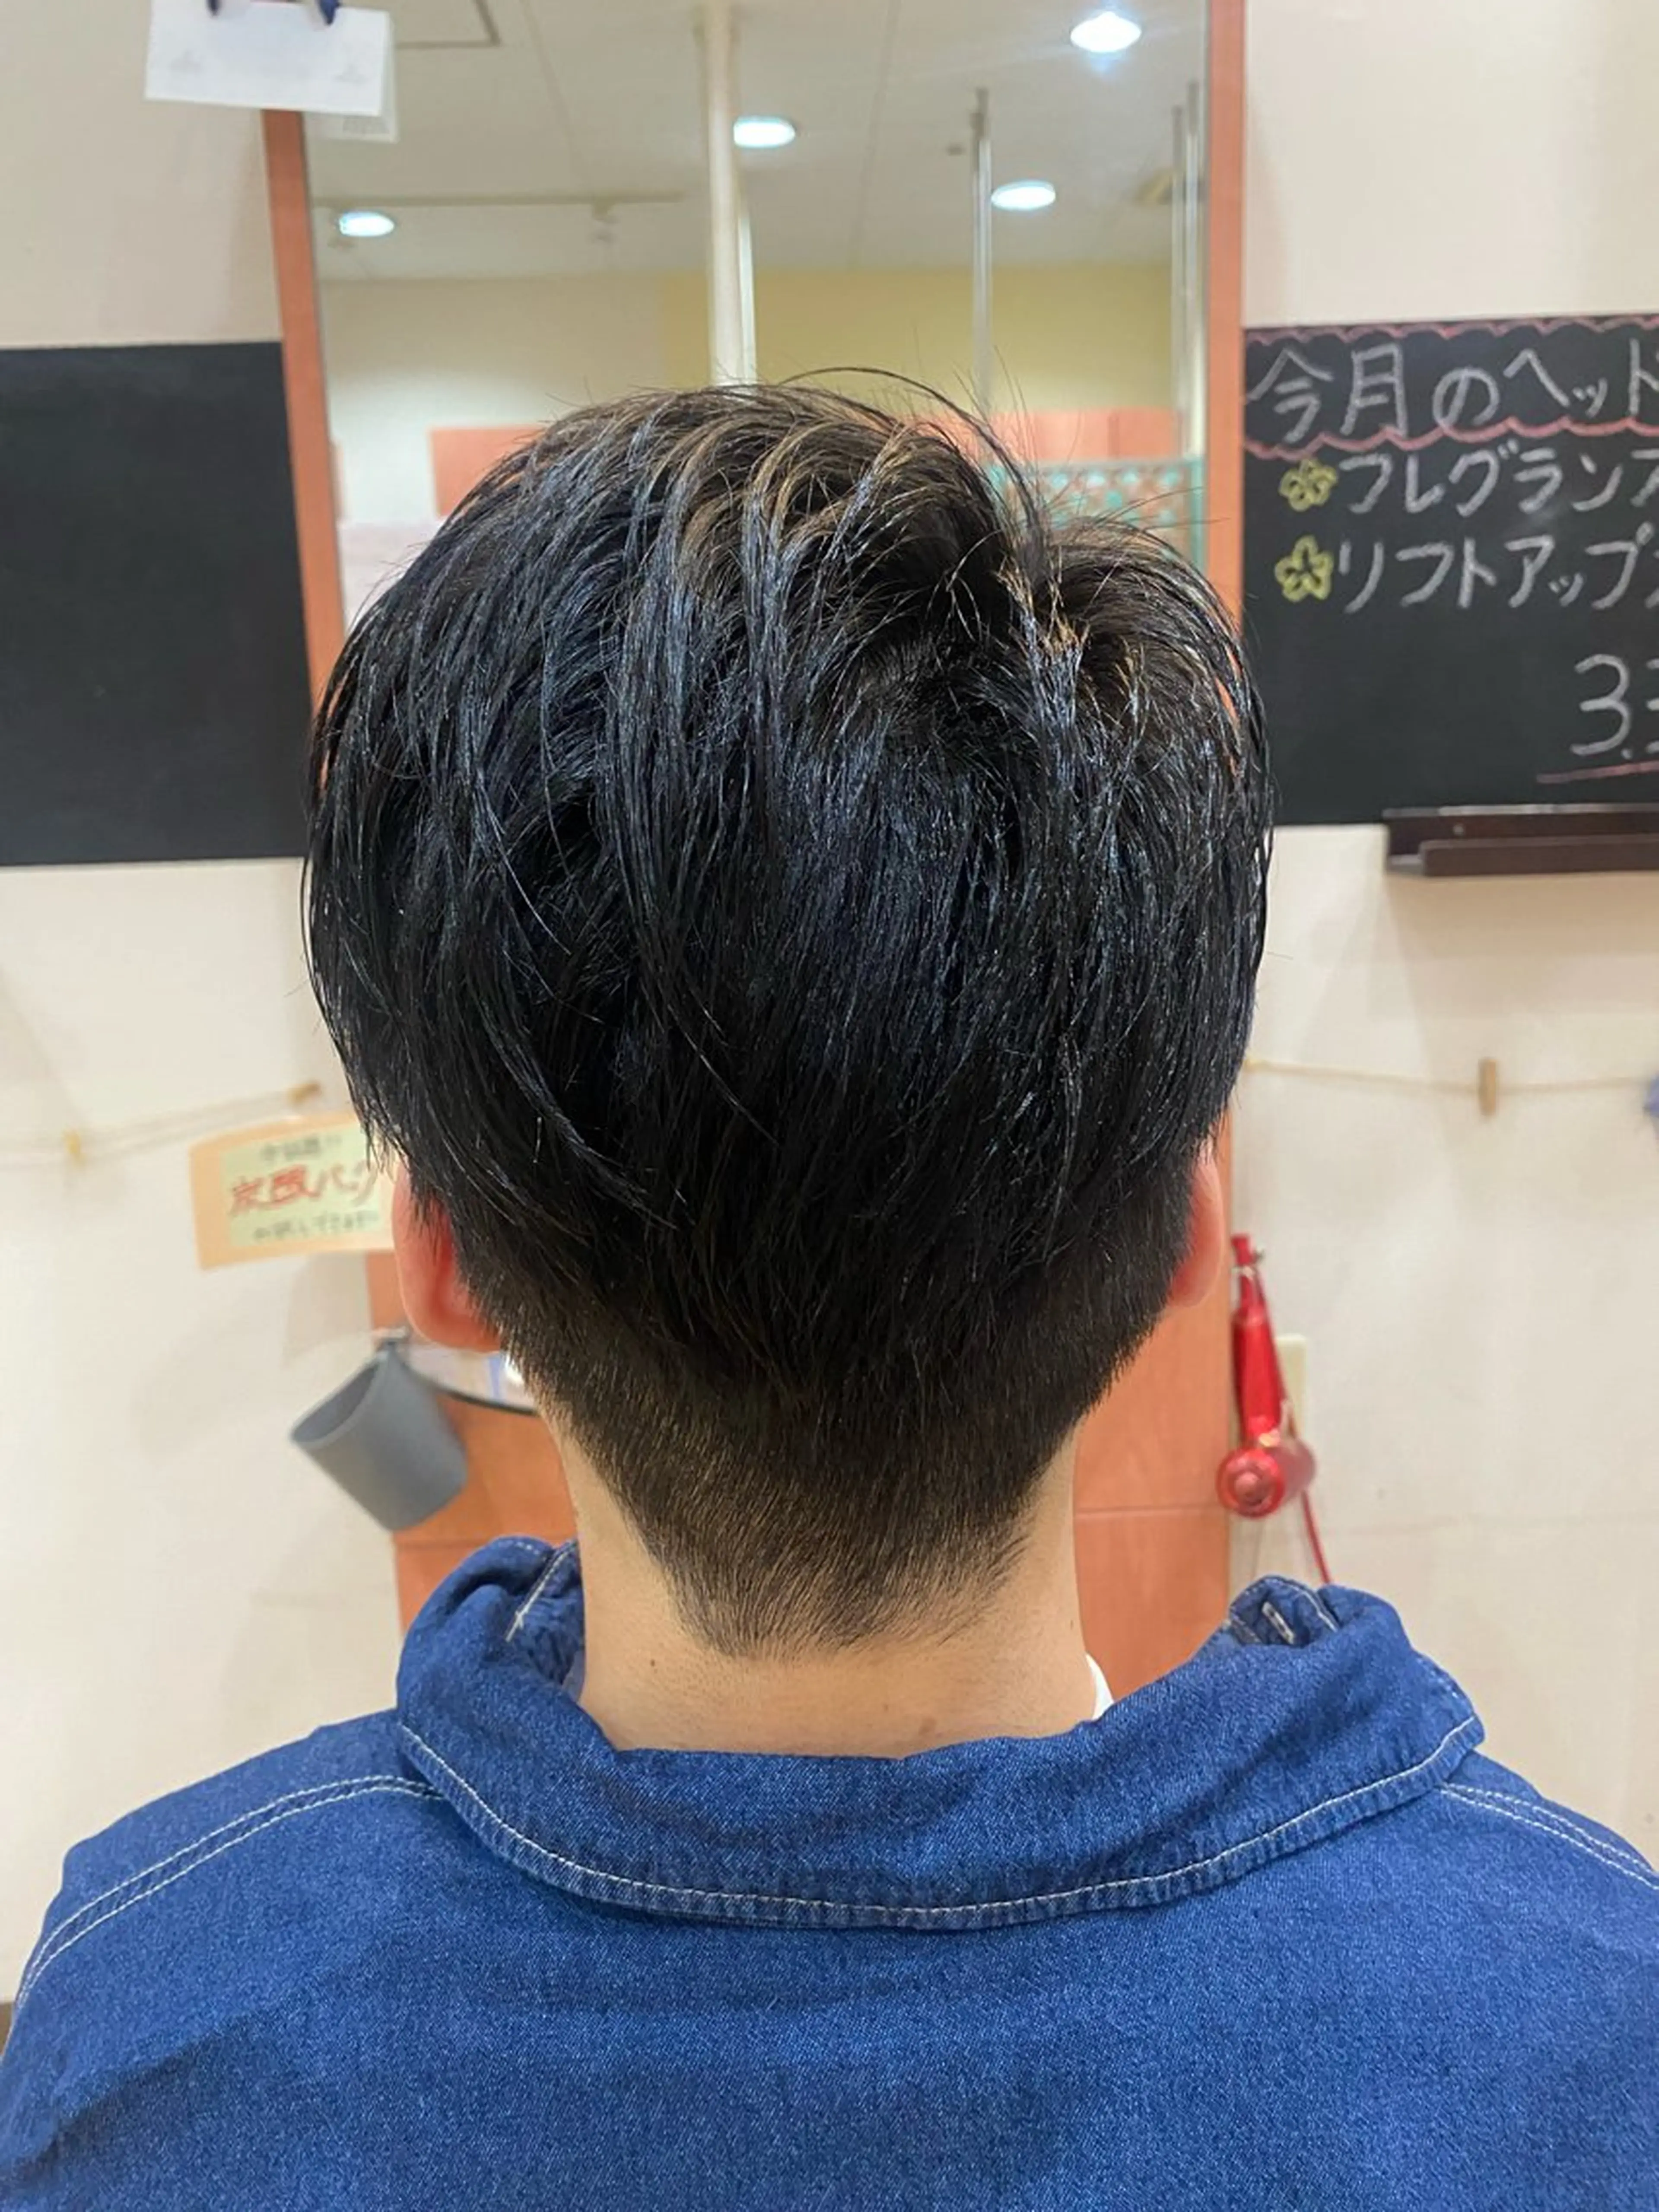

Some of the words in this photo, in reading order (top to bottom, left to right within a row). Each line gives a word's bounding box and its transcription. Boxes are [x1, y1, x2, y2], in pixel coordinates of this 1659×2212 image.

[1338, 521, 1659, 613] リフトアップ
